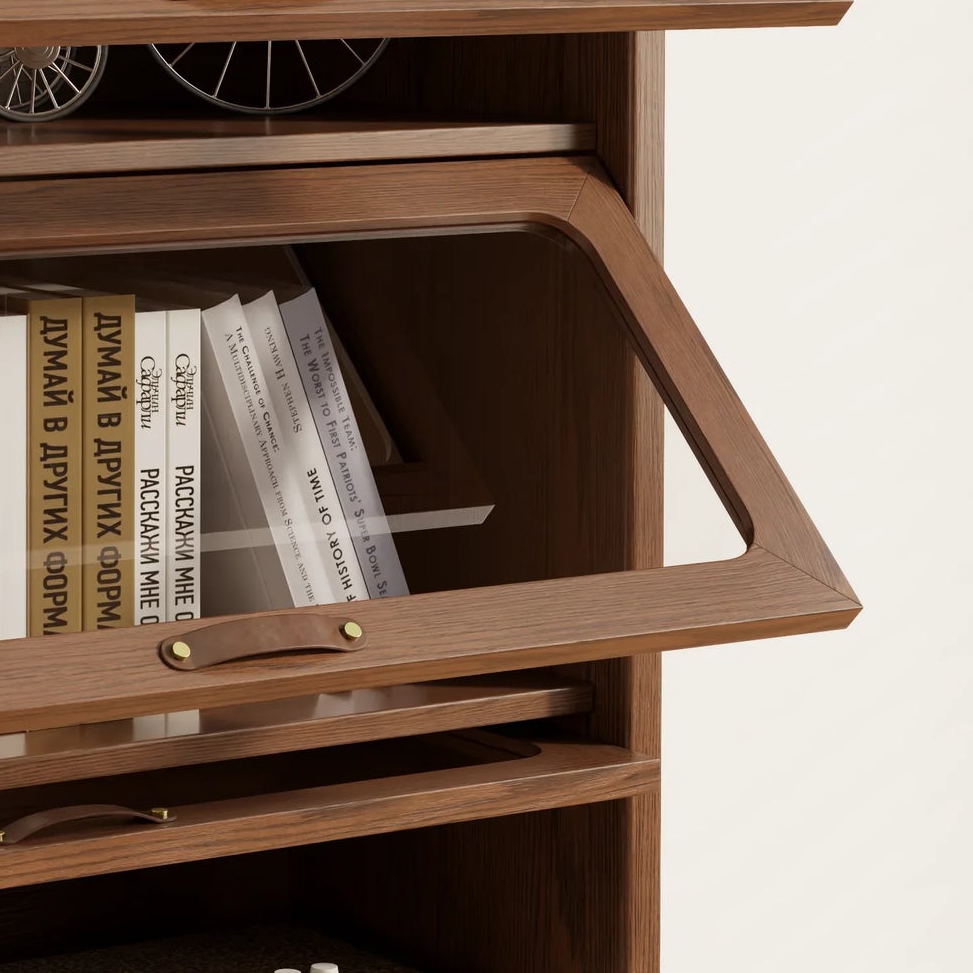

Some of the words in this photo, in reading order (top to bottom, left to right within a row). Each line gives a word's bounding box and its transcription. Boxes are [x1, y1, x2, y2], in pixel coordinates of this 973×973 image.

[40, 316, 74, 407] ДУМАЙ
[94, 312, 128, 403] ДУМАЙ
[136, 355, 155, 429] Сафарли
[171, 353, 189, 426] Сафарли
[43, 417, 68, 432] В
[97, 413, 122, 427] В
[40, 443, 68, 544] ДРУГИХ
[94, 438, 122, 538] ДРУГИХ
[140, 468, 160, 565] РАССКАЖИ
[175, 465, 195, 562] РАССКАЖИ
[307, 467, 325, 503] TIME
[318, 506, 332, 525] OF
[140, 571, 160, 609] МНЕ
[175, 567, 195, 606] МНЕ
[327, 531, 353, 591] HISTORY
